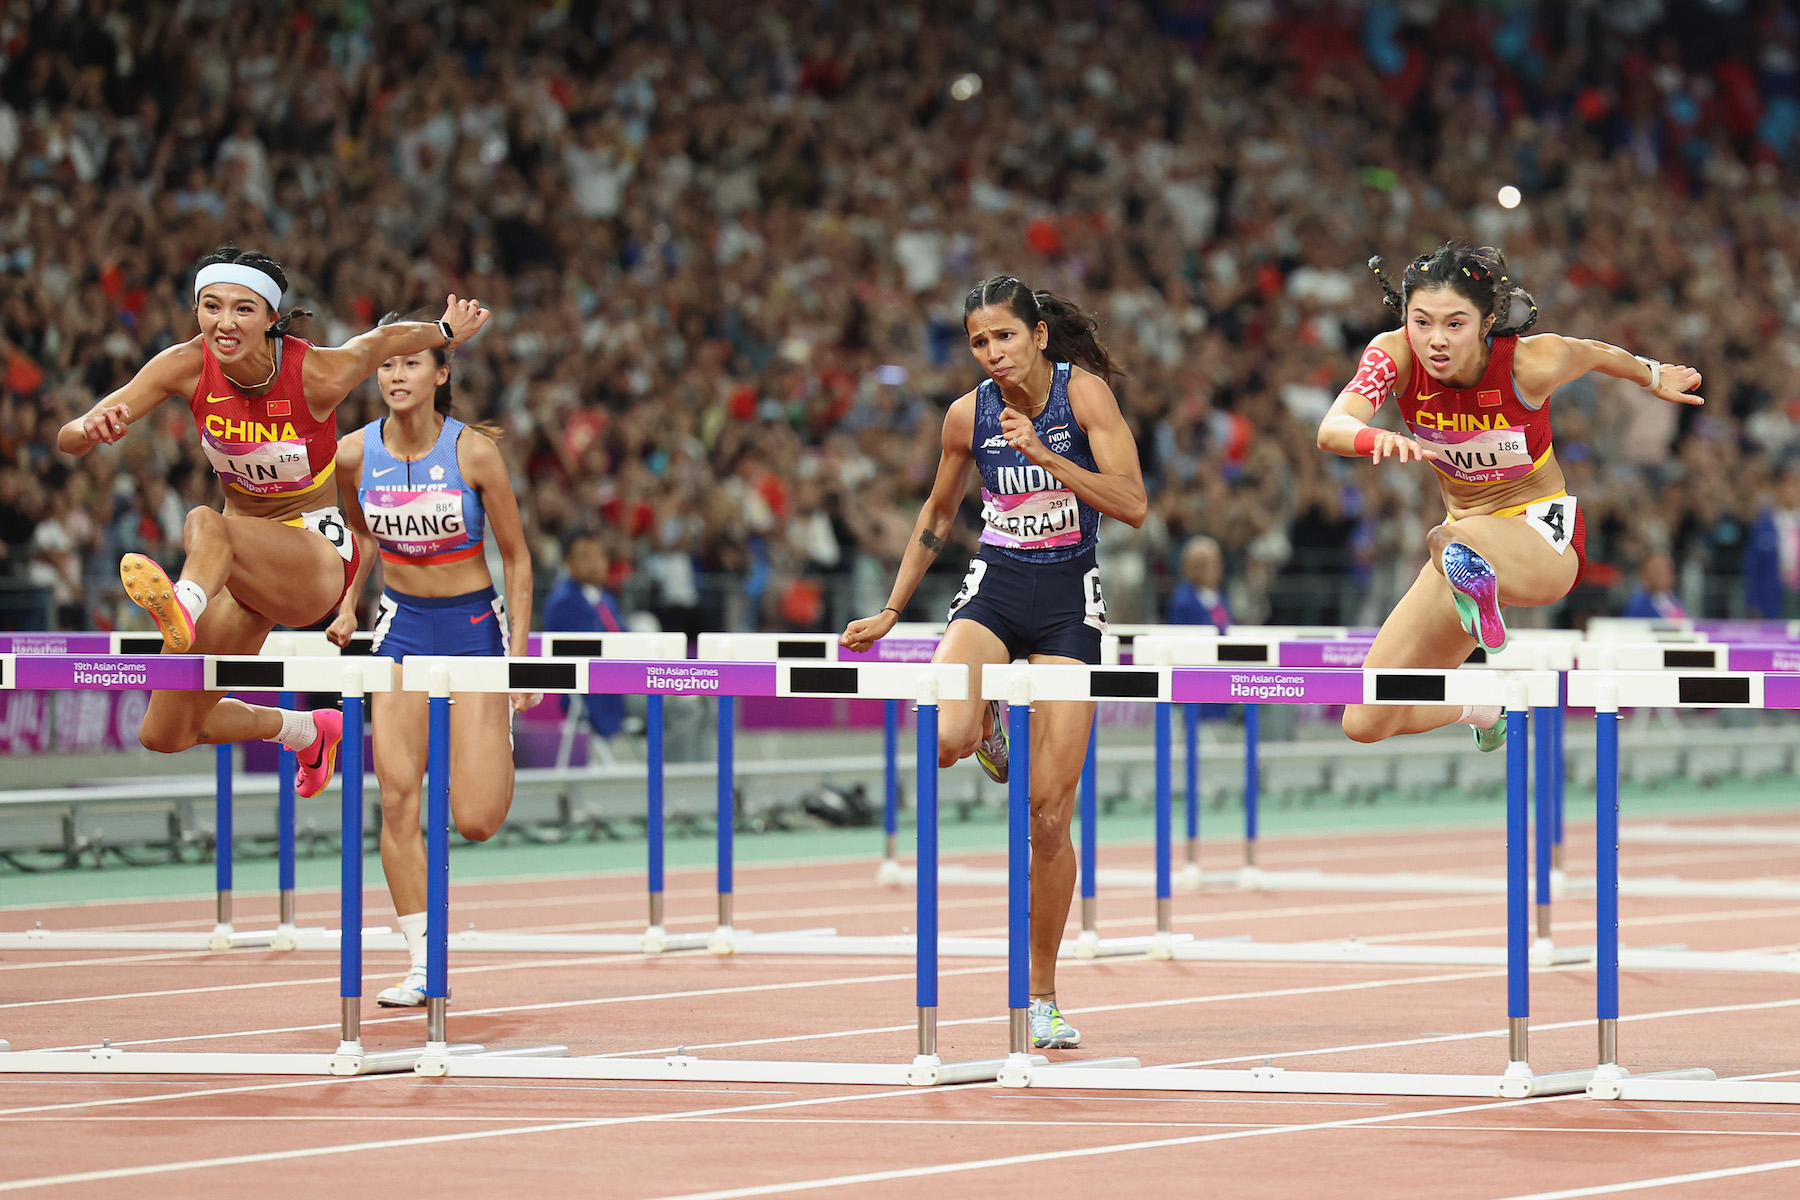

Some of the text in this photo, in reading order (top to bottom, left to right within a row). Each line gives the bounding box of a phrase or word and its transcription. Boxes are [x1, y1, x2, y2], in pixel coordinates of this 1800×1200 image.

[1416, 410, 1511, 431] CHINA
[206, 414, 299, 443] CHINA
[980, 438, 1008, 449] JSW
[1048, 431, 1071, 443] INDIA
[1498, 441, 1519, 451] 186
[279, 454, 300, 462] 175
[1445, 450, 1497, 469] WU
[228, 459, 278, 480] LIN
[435, 503, 454, 512] 885
[1050, 498, 1069, 509] 297
[369, 514, 460, 536] ZHANG
[1537, 503, 1564, 543] 4
[73, 662, 146, 671] 19th Asian Games
[646, 667, 719, 676] 19th Asian Games
[73, 671, 146, 686] Hangzhou
[646, 675, 719, 691] Hangzhou
[1230, 674, 1305, 684] 19th Asian Games
[1230, 683, 1305, 699] Hangzhou
